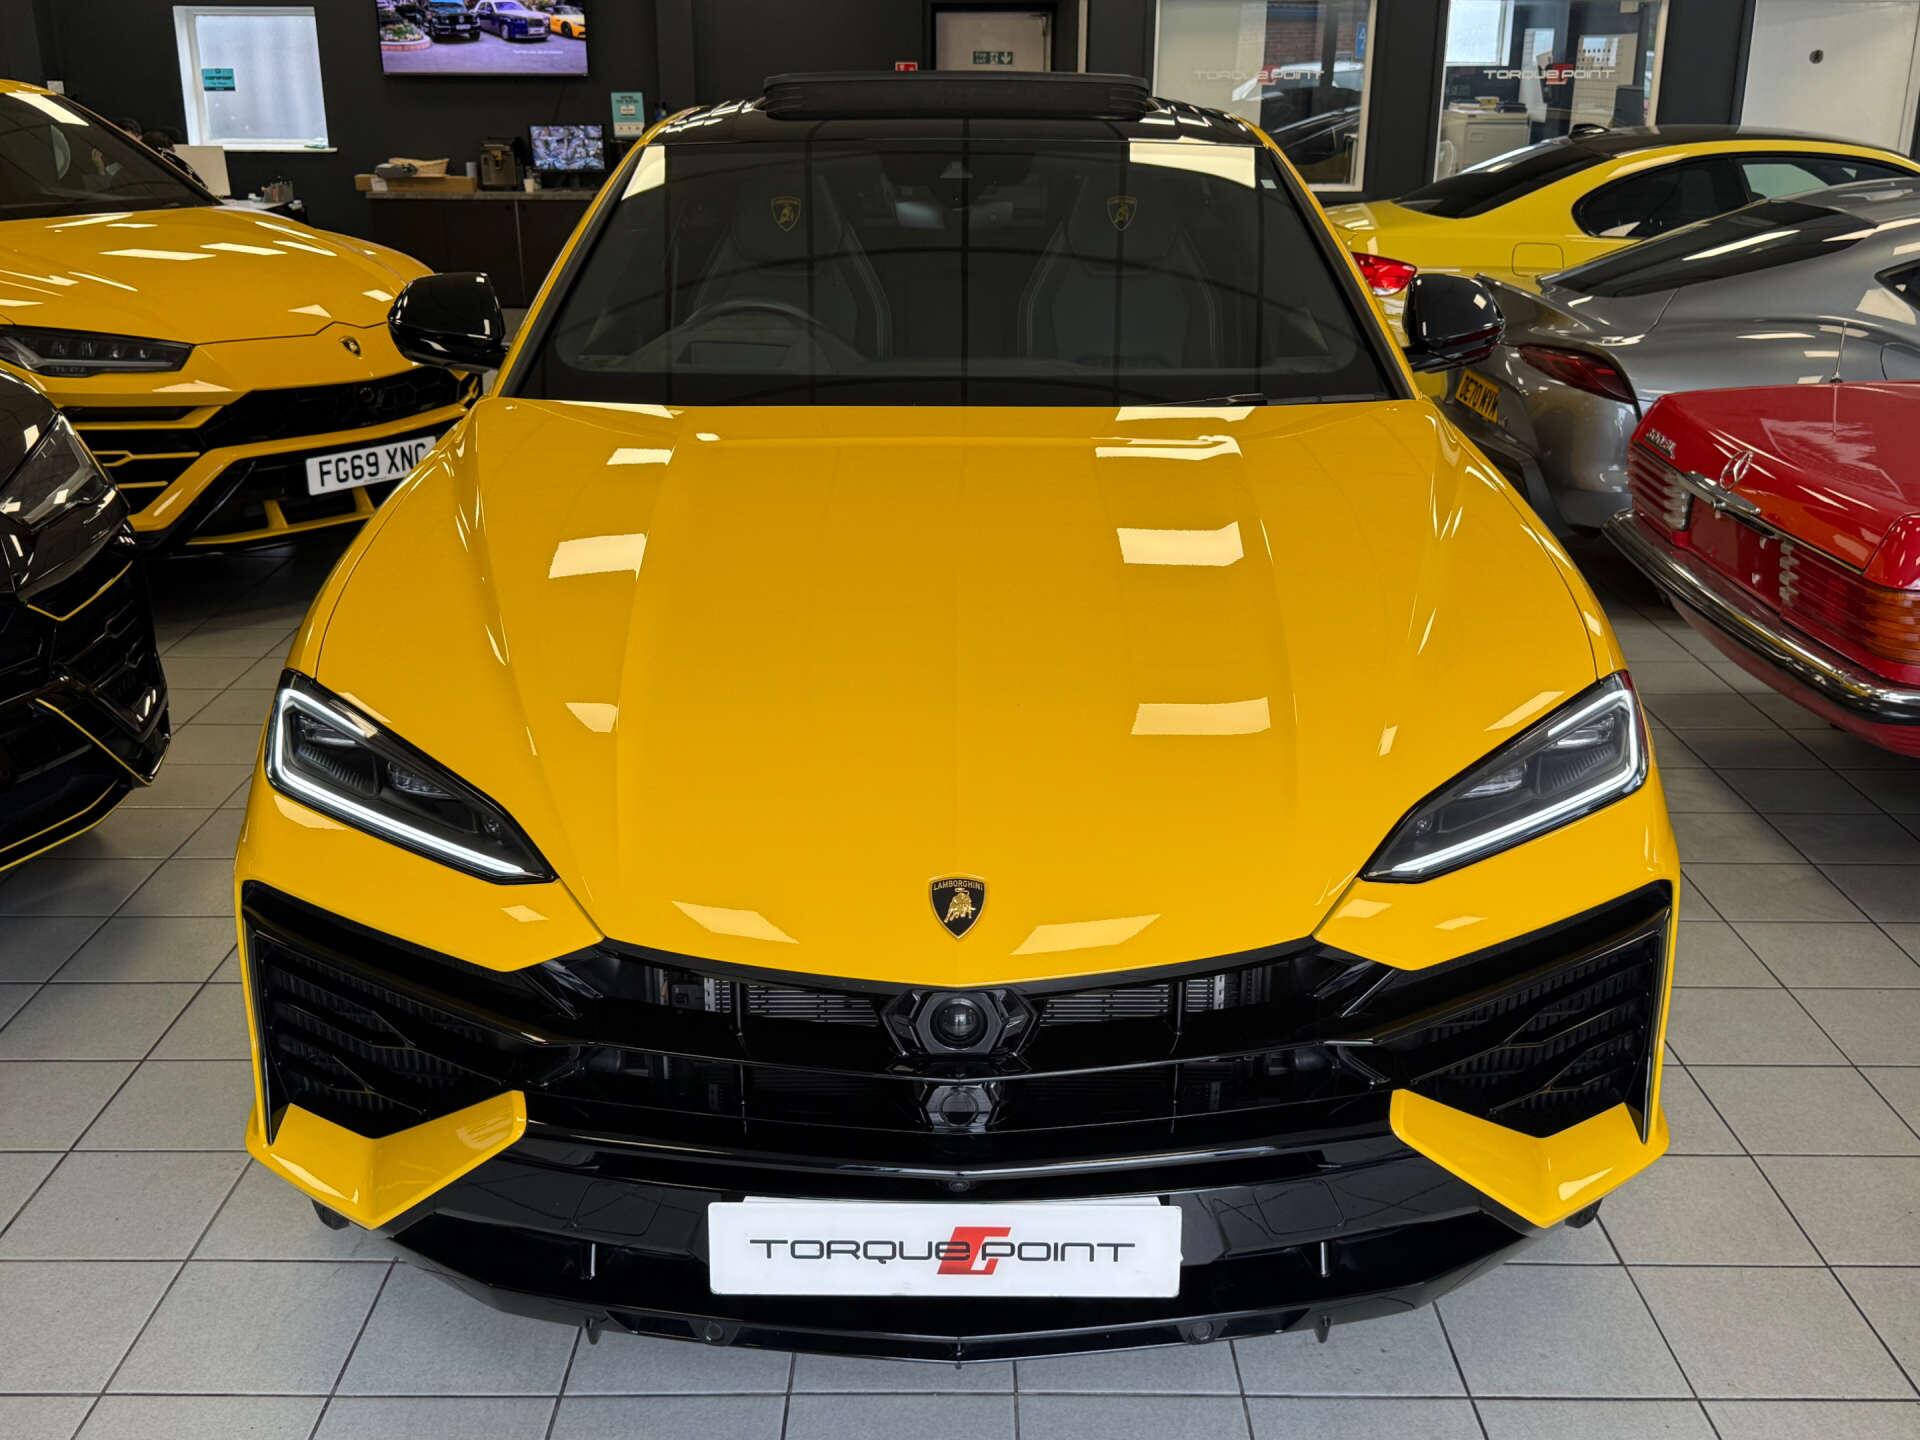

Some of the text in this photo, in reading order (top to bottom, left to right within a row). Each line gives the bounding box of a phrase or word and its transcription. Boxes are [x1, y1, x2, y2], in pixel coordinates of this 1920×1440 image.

[1193, 69, 1267, 81] TORQE
[1483, 69, 1616, 80] TORQUE POINT
[318, 451, 381, 487] FG69
[933, 880, 983, 891] LAMBORGHINI
[749, 1238, 1136, 1265] TORQUE POINT
